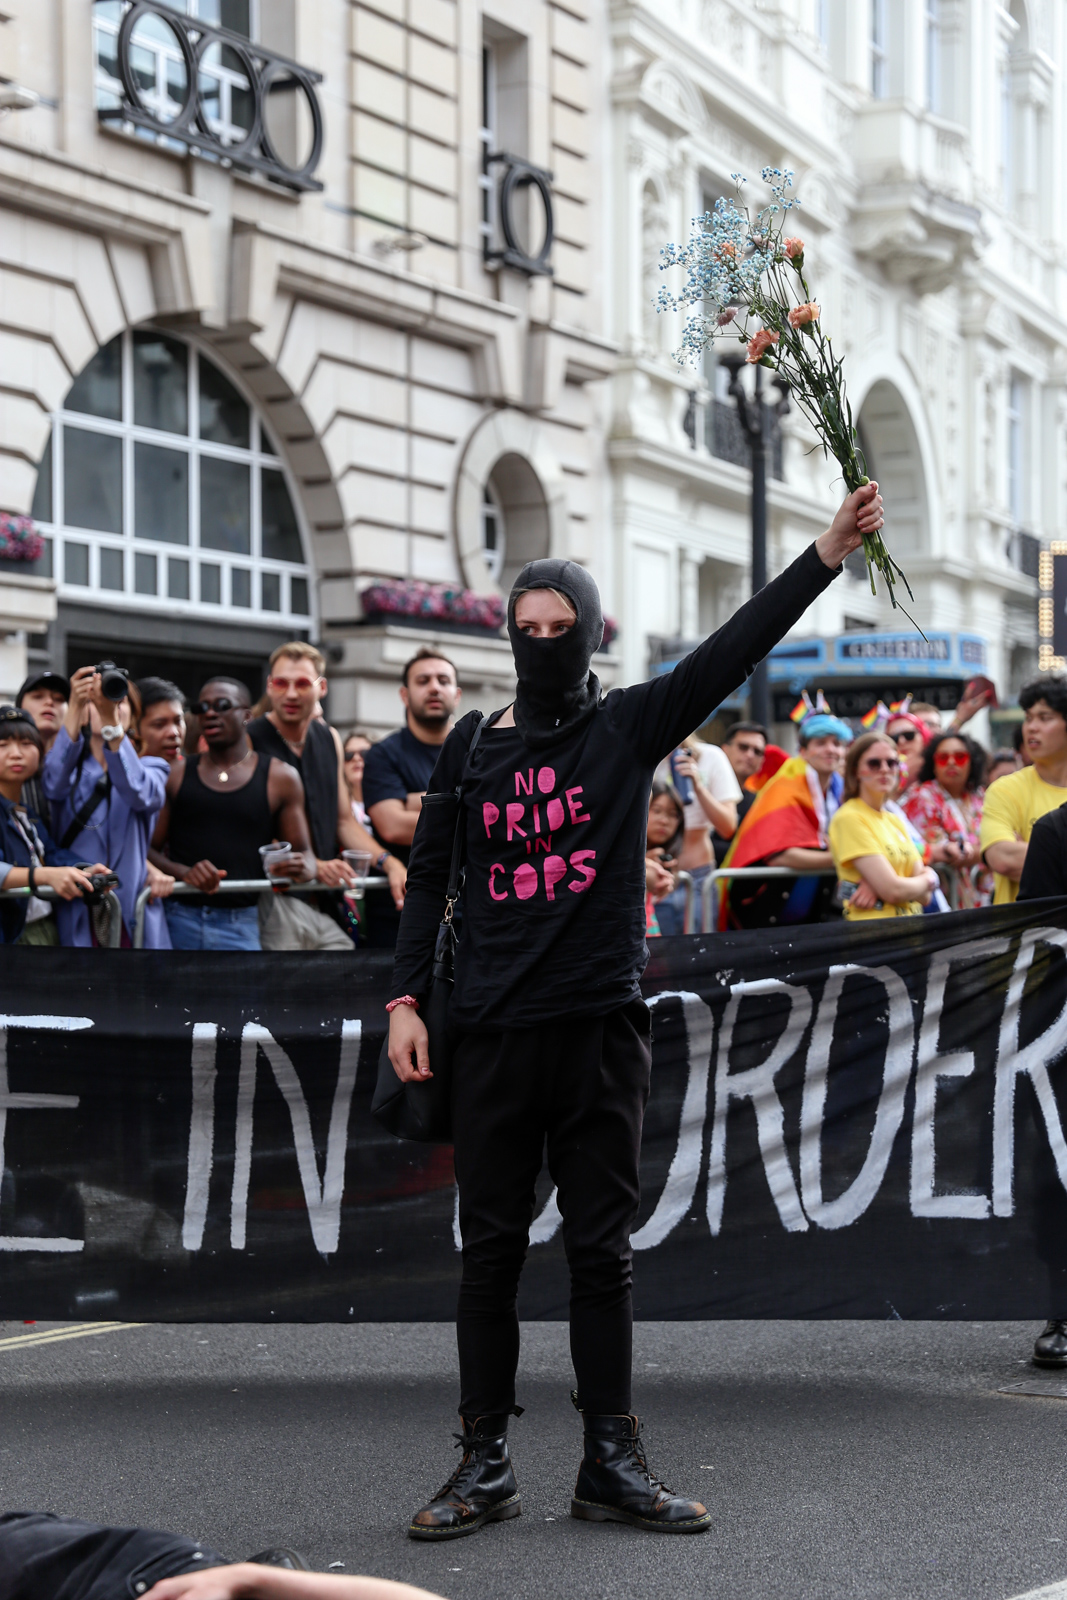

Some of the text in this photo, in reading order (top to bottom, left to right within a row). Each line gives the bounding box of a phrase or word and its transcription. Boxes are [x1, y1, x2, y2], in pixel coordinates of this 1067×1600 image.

[848, 639, 948, 660] CRITERION
[514, 766, 556, 796] NO
[482, 785, 591, 841] PRIDE
[525, 834, 552, 854] IN
[488, 849, 597, 901] COPS
[182, 1018, 362, 1256] IN
